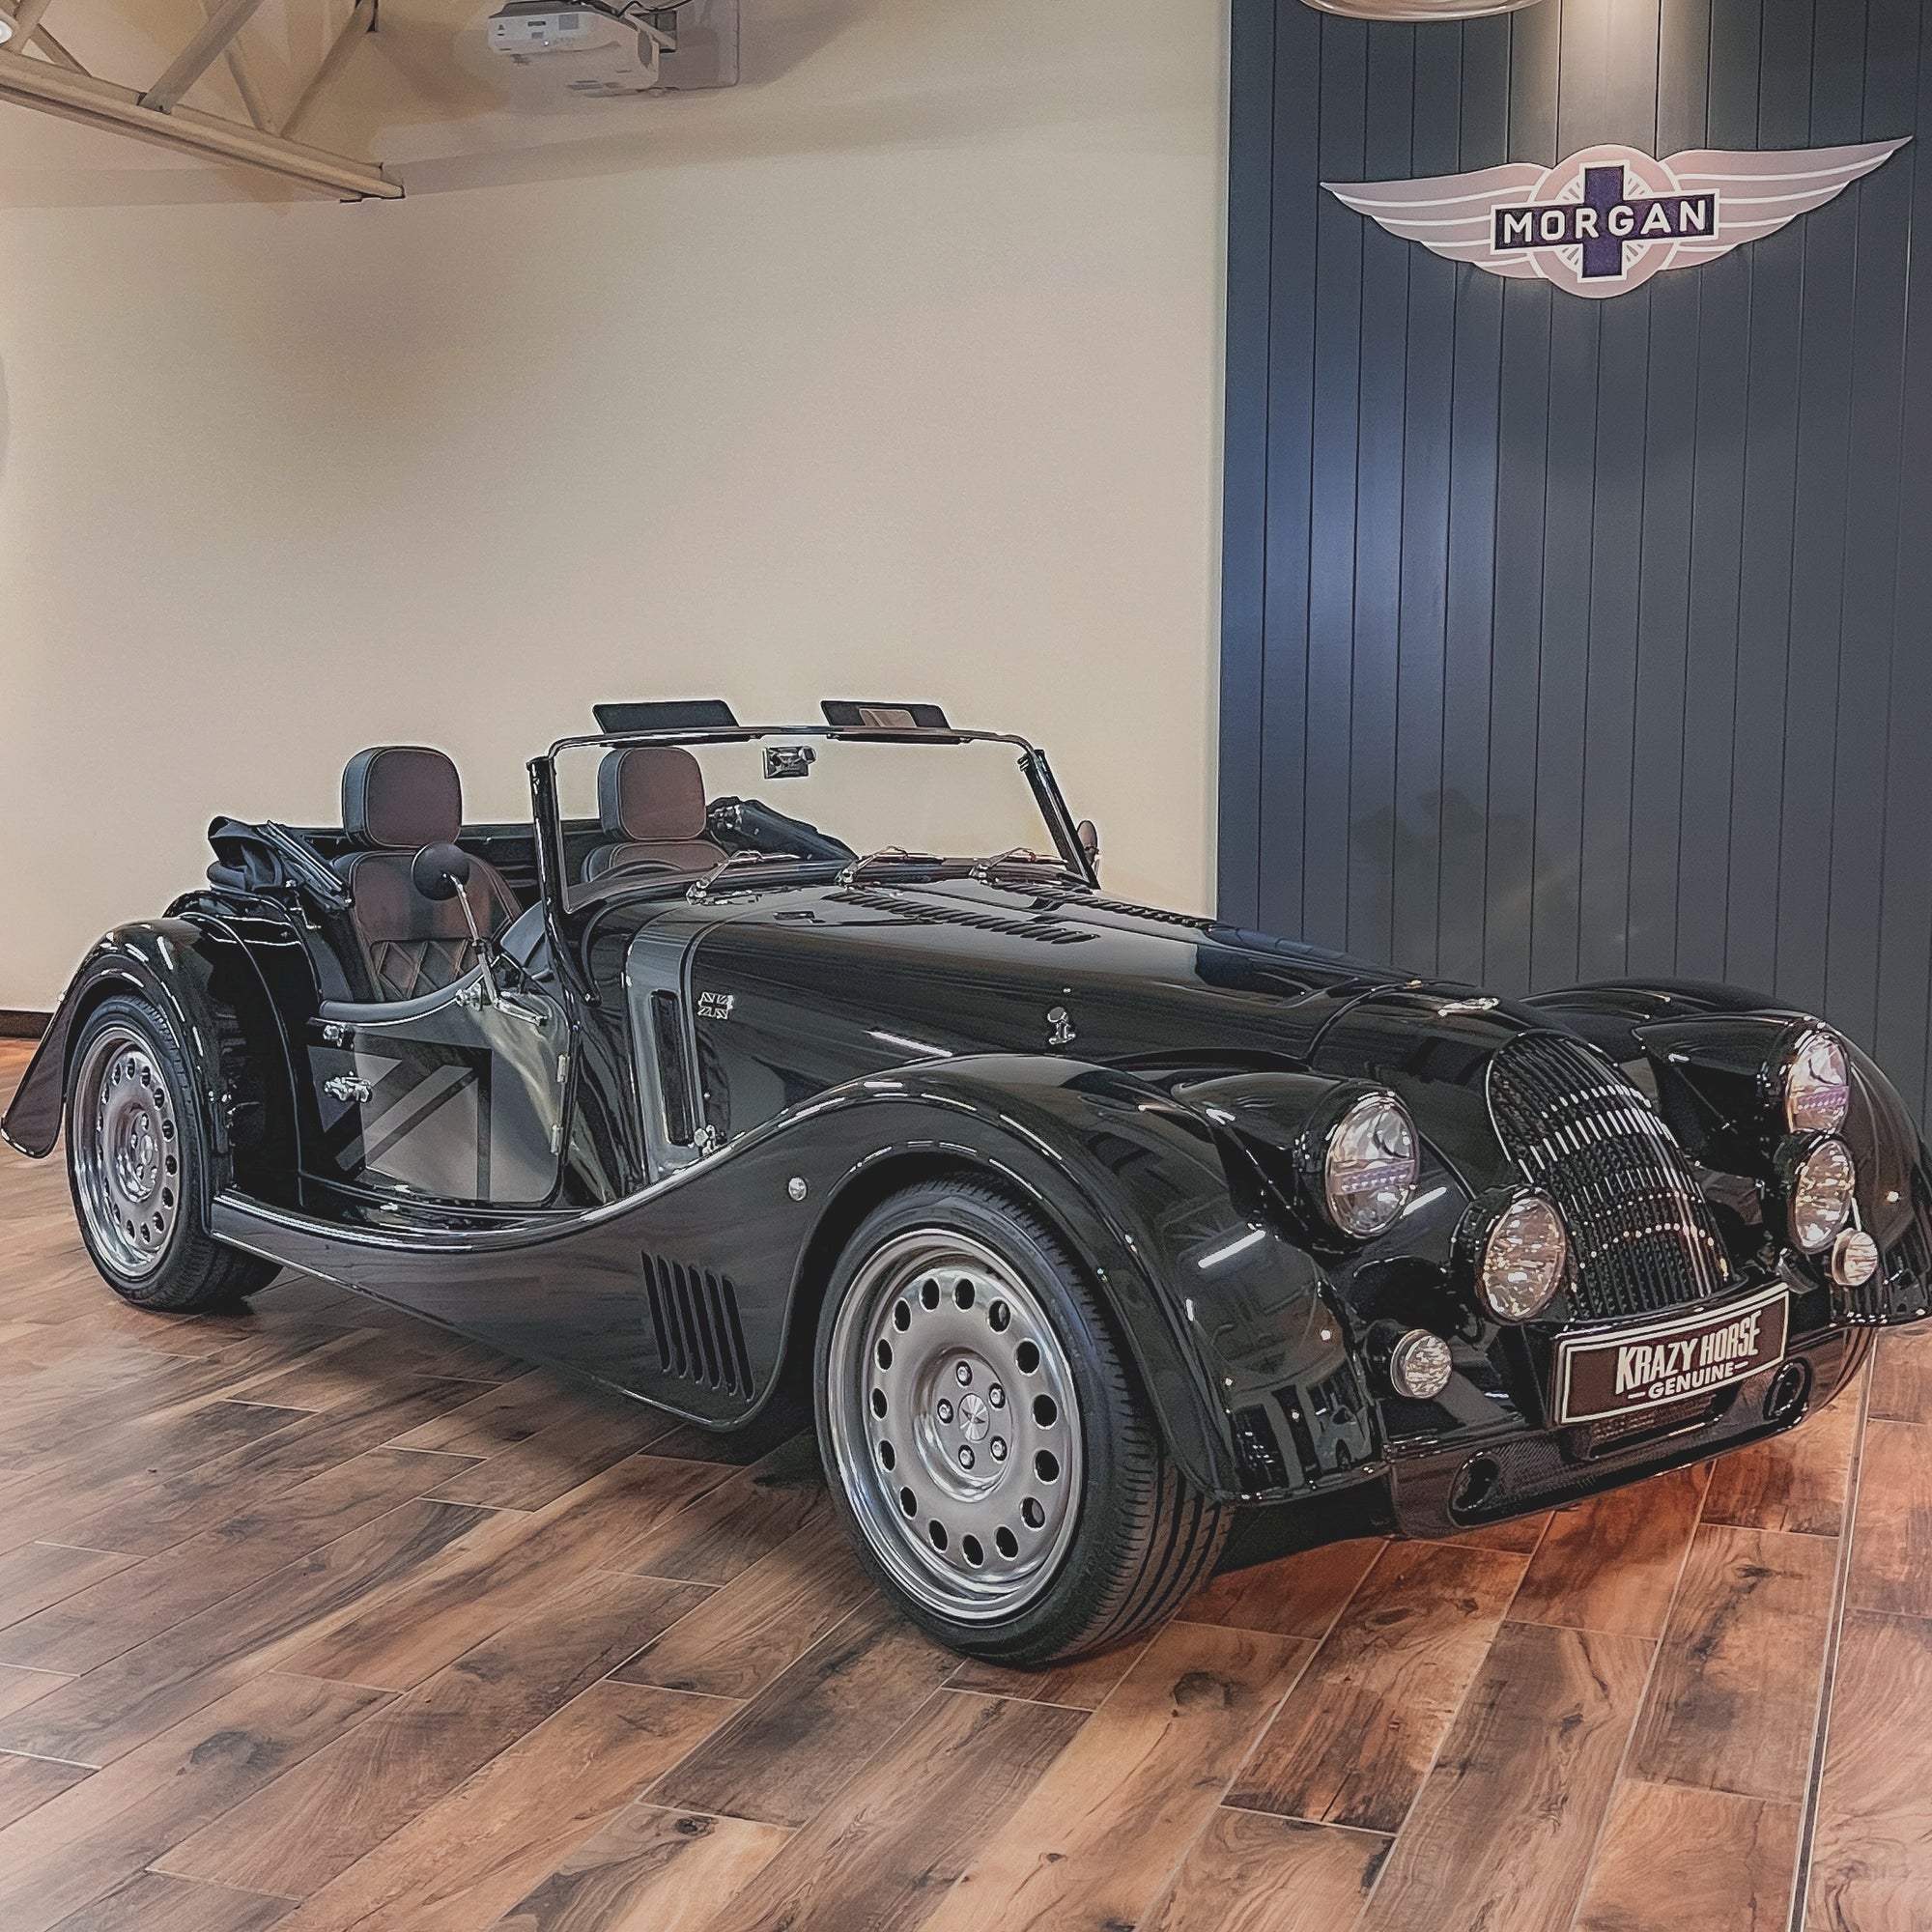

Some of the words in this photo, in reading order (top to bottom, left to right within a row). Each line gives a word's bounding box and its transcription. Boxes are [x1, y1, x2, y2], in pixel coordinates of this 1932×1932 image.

[1503, 199, 1706, 244] MORGAN
[1615, 1338, 1699, 1395] KRAZY
[1699, 1310, 1762, 1367] HORSE
[1648, 1361, 1735, 1400] GENUINE
